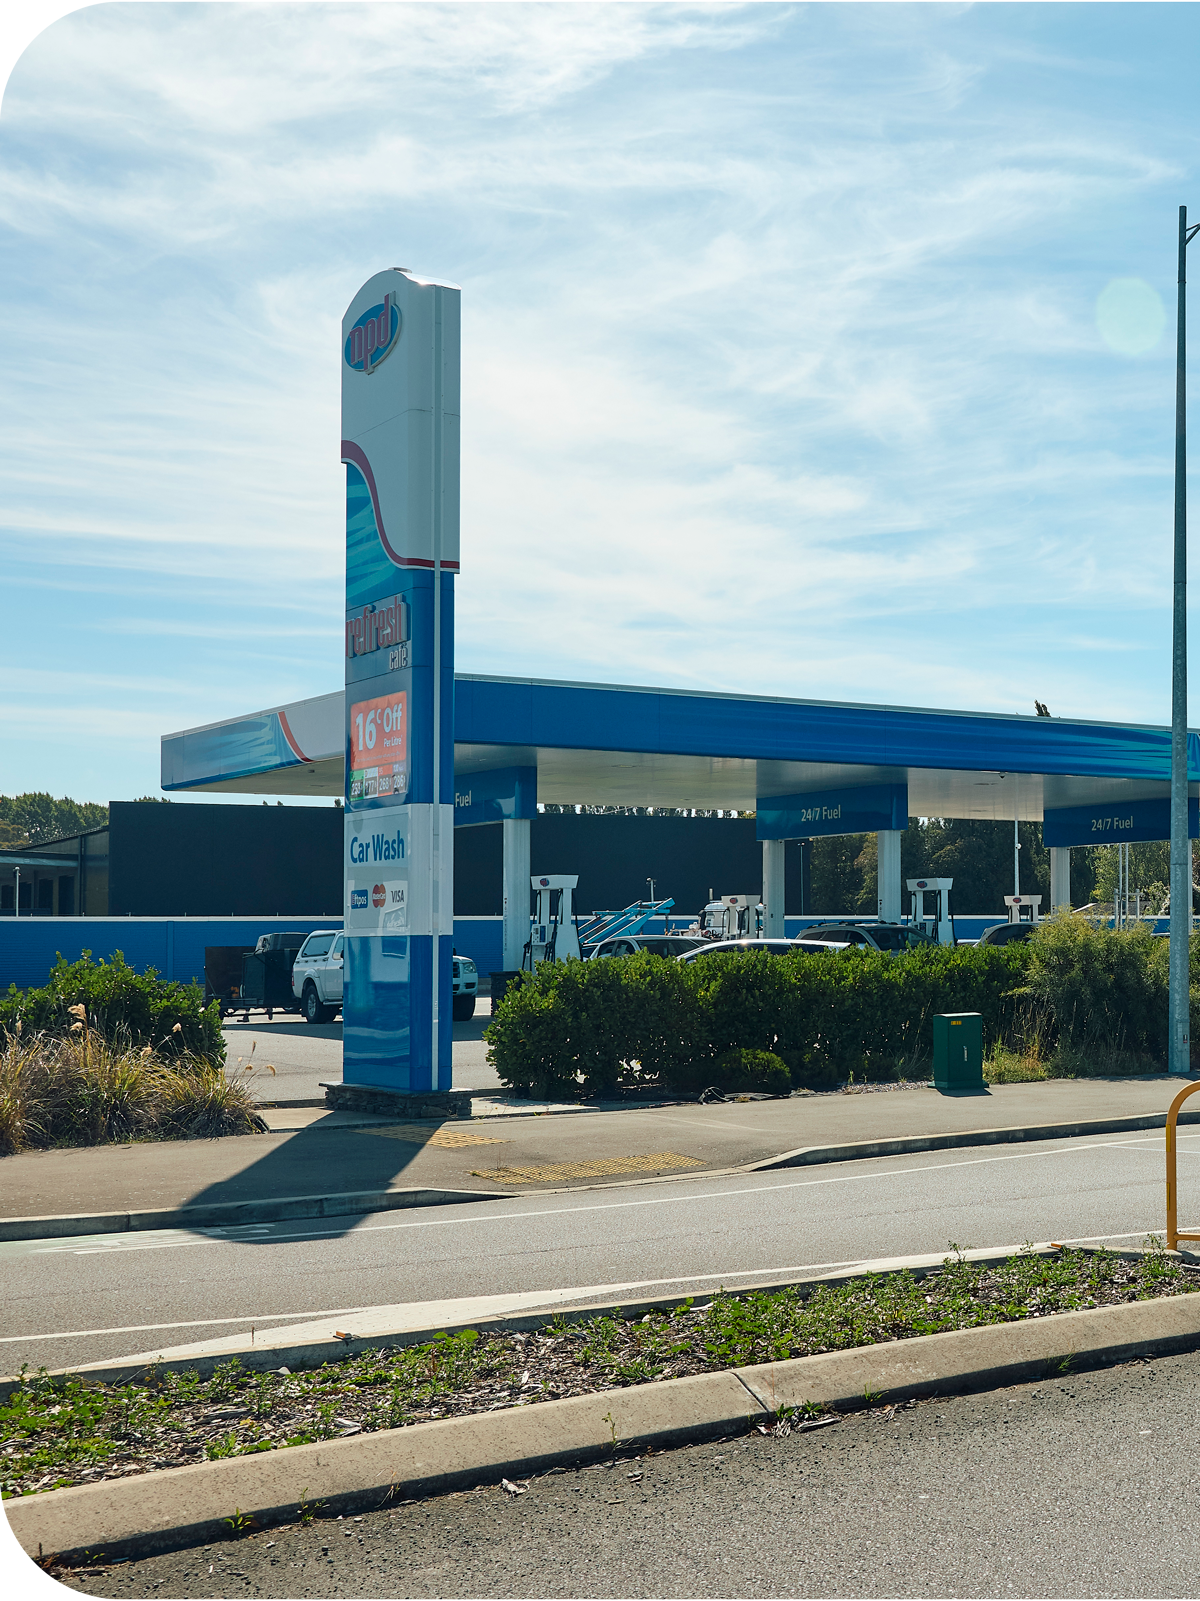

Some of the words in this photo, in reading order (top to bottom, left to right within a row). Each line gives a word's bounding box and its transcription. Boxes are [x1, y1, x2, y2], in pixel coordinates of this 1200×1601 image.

[349, 291, 396, 375] npd
[346, 593, 407, 658] refresh
[383, 703, 402, 733] Off
[455, 790, 472, 807] Fuel
[801, 807, 820, 821] 24/7
[822, 804, 841, 820] Fuel
[1091, 817, 1112, 831] 24/7
[1113, 815, 1133, 830] Fuel
[350, 836, 370, 864] Car
[371, 829, 405, 861] Wash
[390, 889, 405, 903] VISA
